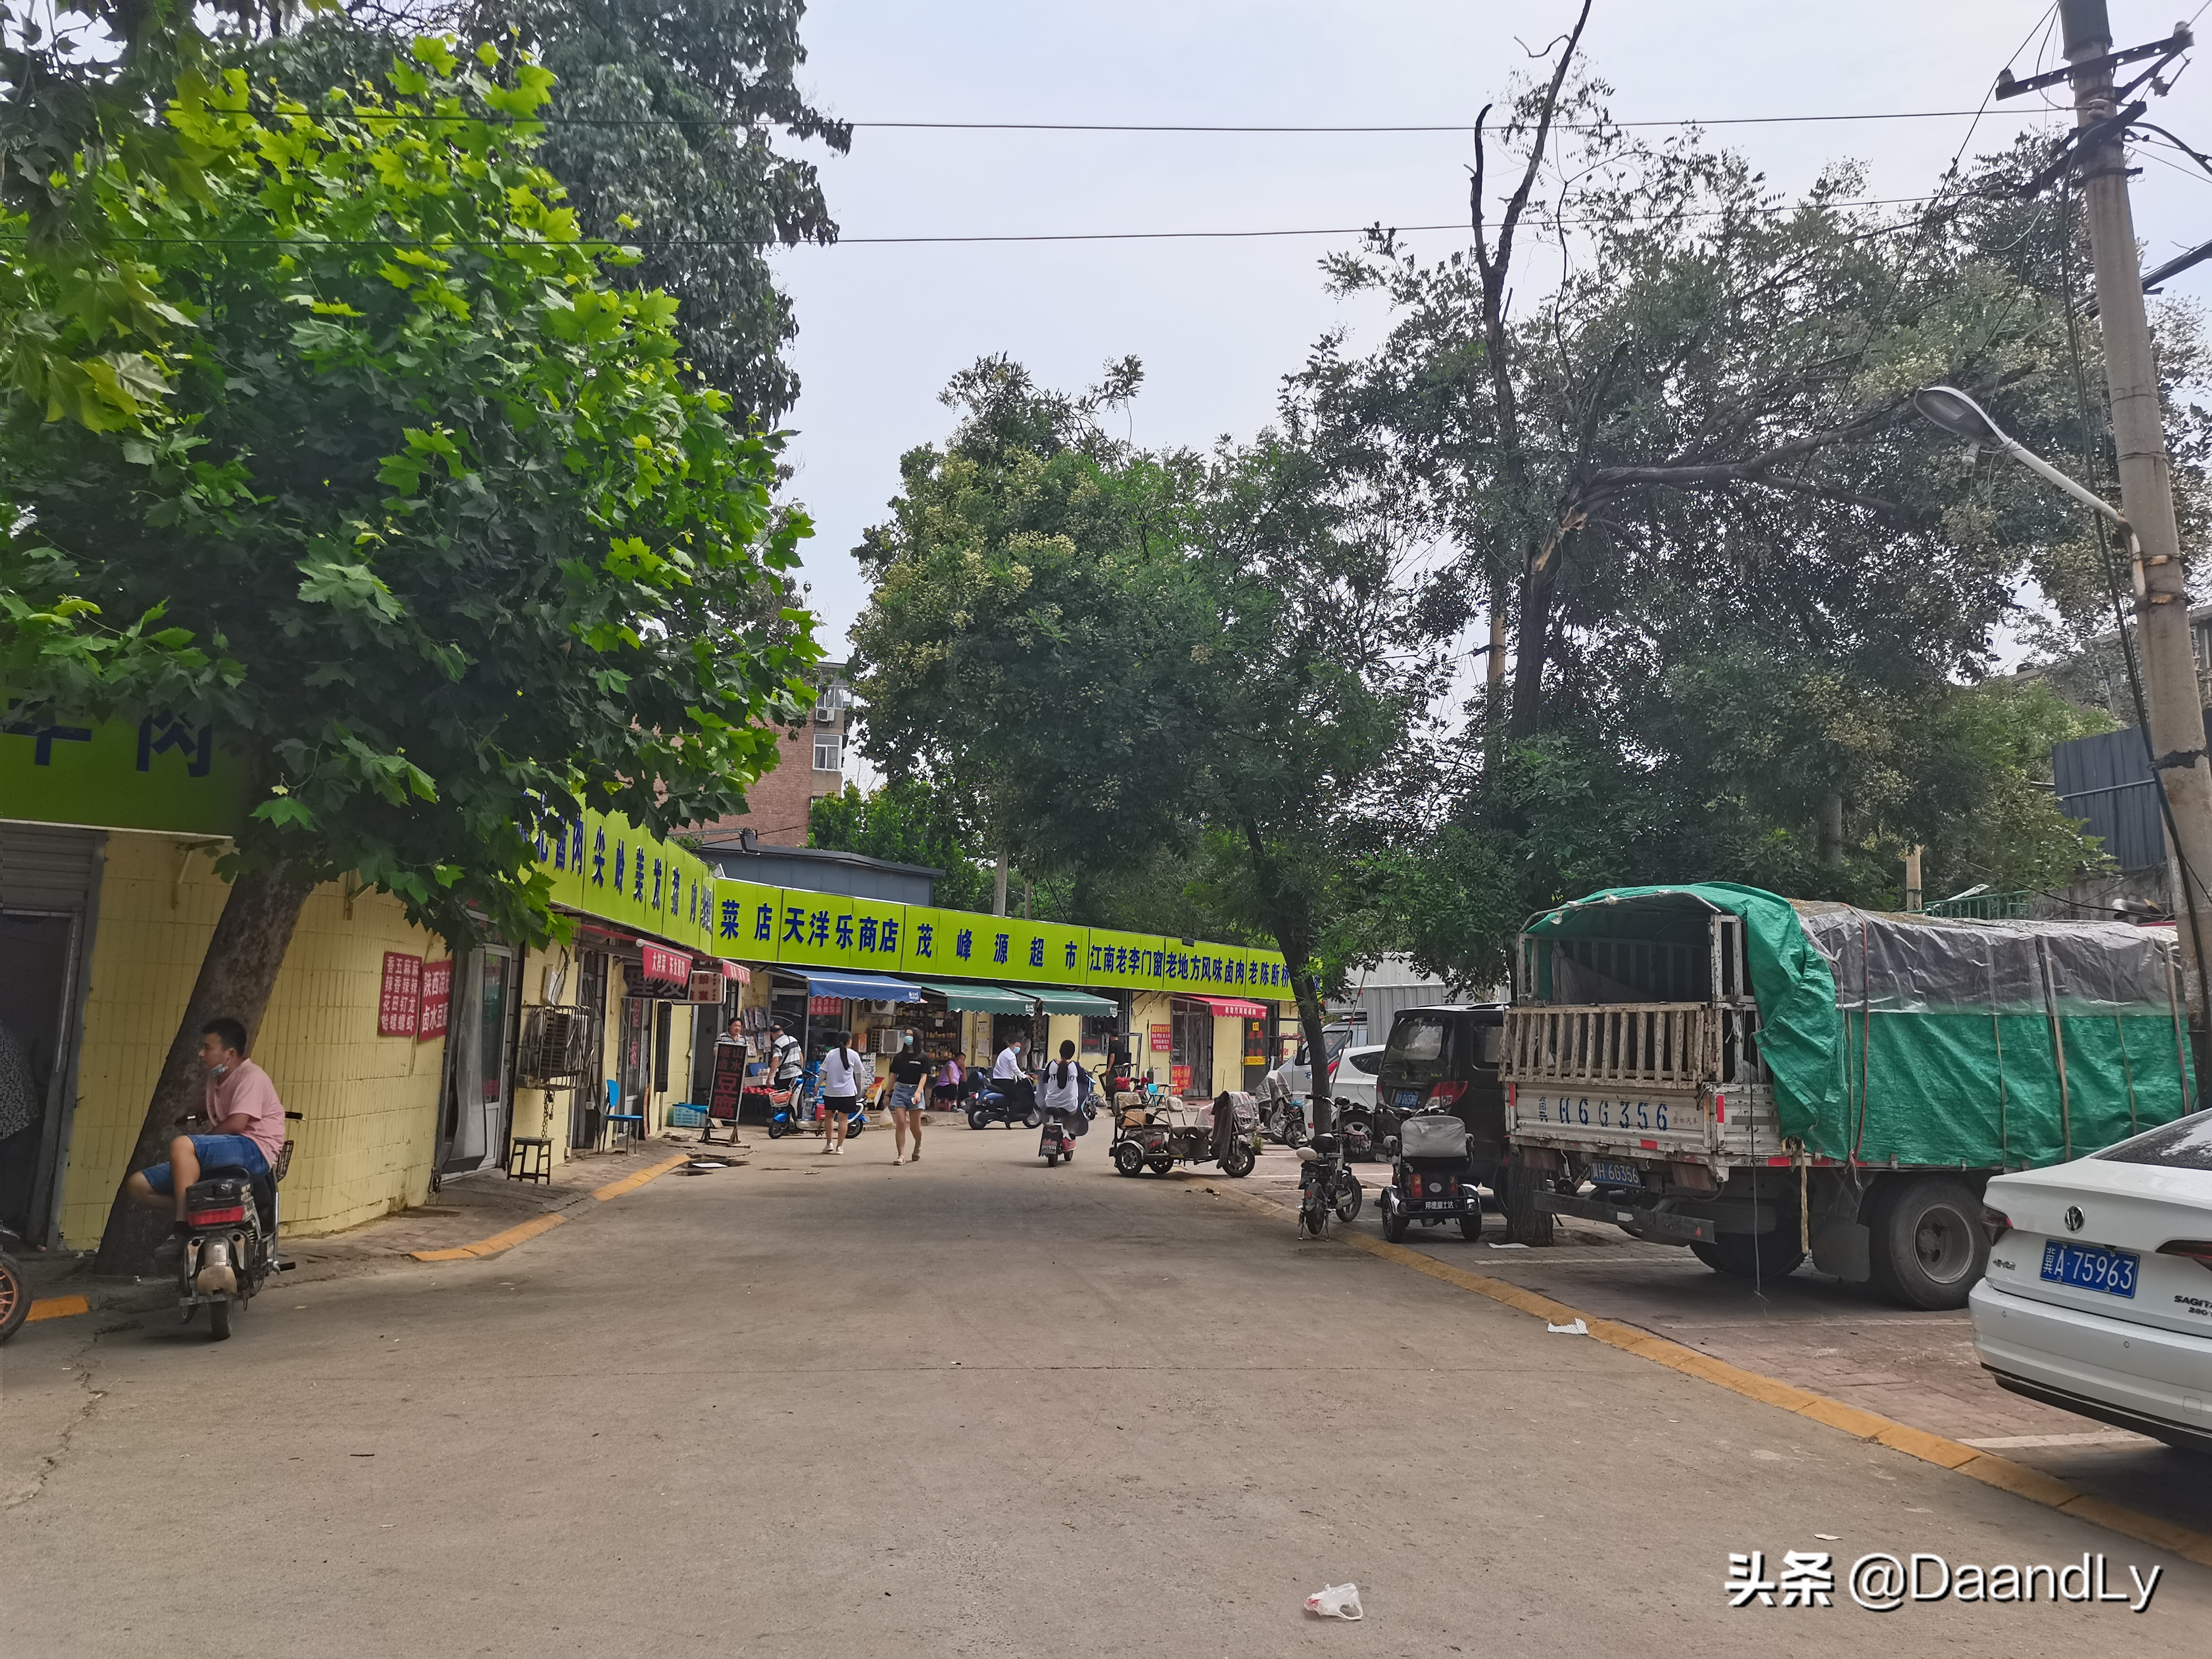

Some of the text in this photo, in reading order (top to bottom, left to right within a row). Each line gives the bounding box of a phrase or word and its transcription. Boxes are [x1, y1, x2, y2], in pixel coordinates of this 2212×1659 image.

[783, 907, 899, 953] 天洋乐商店
[916, 923, 1078, 971] 茂峰源超市
[1089, 943, 1164, 977] 江南老李门窗
[1165, 950, 1245, 985] 老地方风味卤肉
